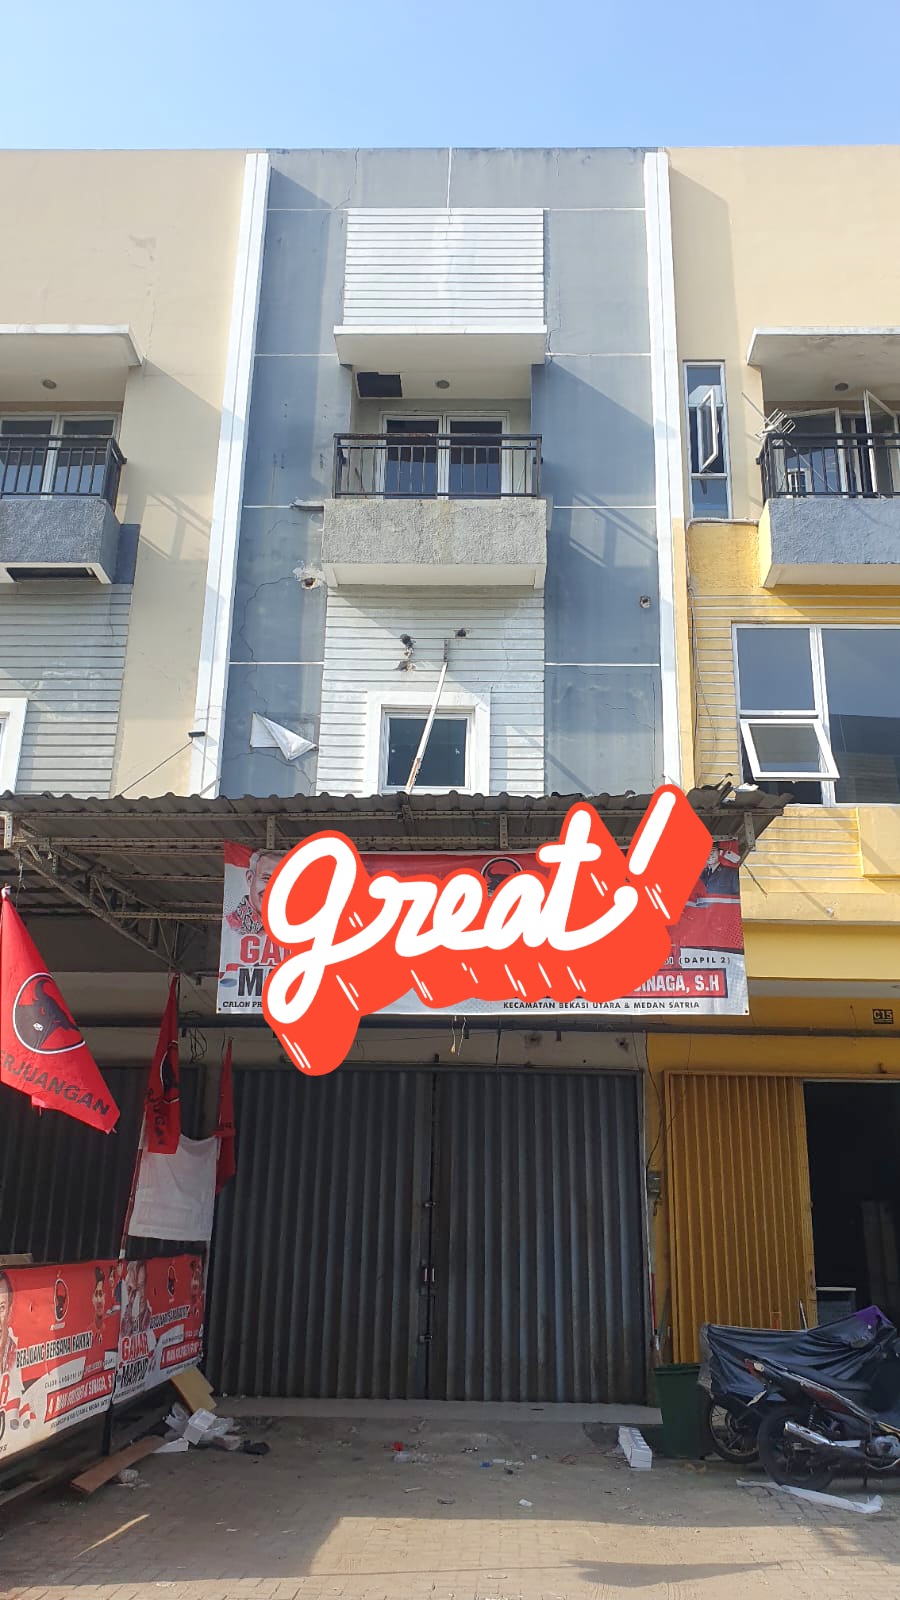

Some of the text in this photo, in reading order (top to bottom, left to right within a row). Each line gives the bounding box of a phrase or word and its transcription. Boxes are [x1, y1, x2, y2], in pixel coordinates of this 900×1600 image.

[680, 956, 717, 966] (DAPIL
[720, 956, 731, 966] 2)
[634, 975, 690, 993] INAGA,
[503, 1001, 556, 1009] KECAMATAN
[592, 1001, 621, 1009] UTARA
[633, 1001, 666, 1009] MEDAN
[668, 1001, 700, 1009] SATRIA
